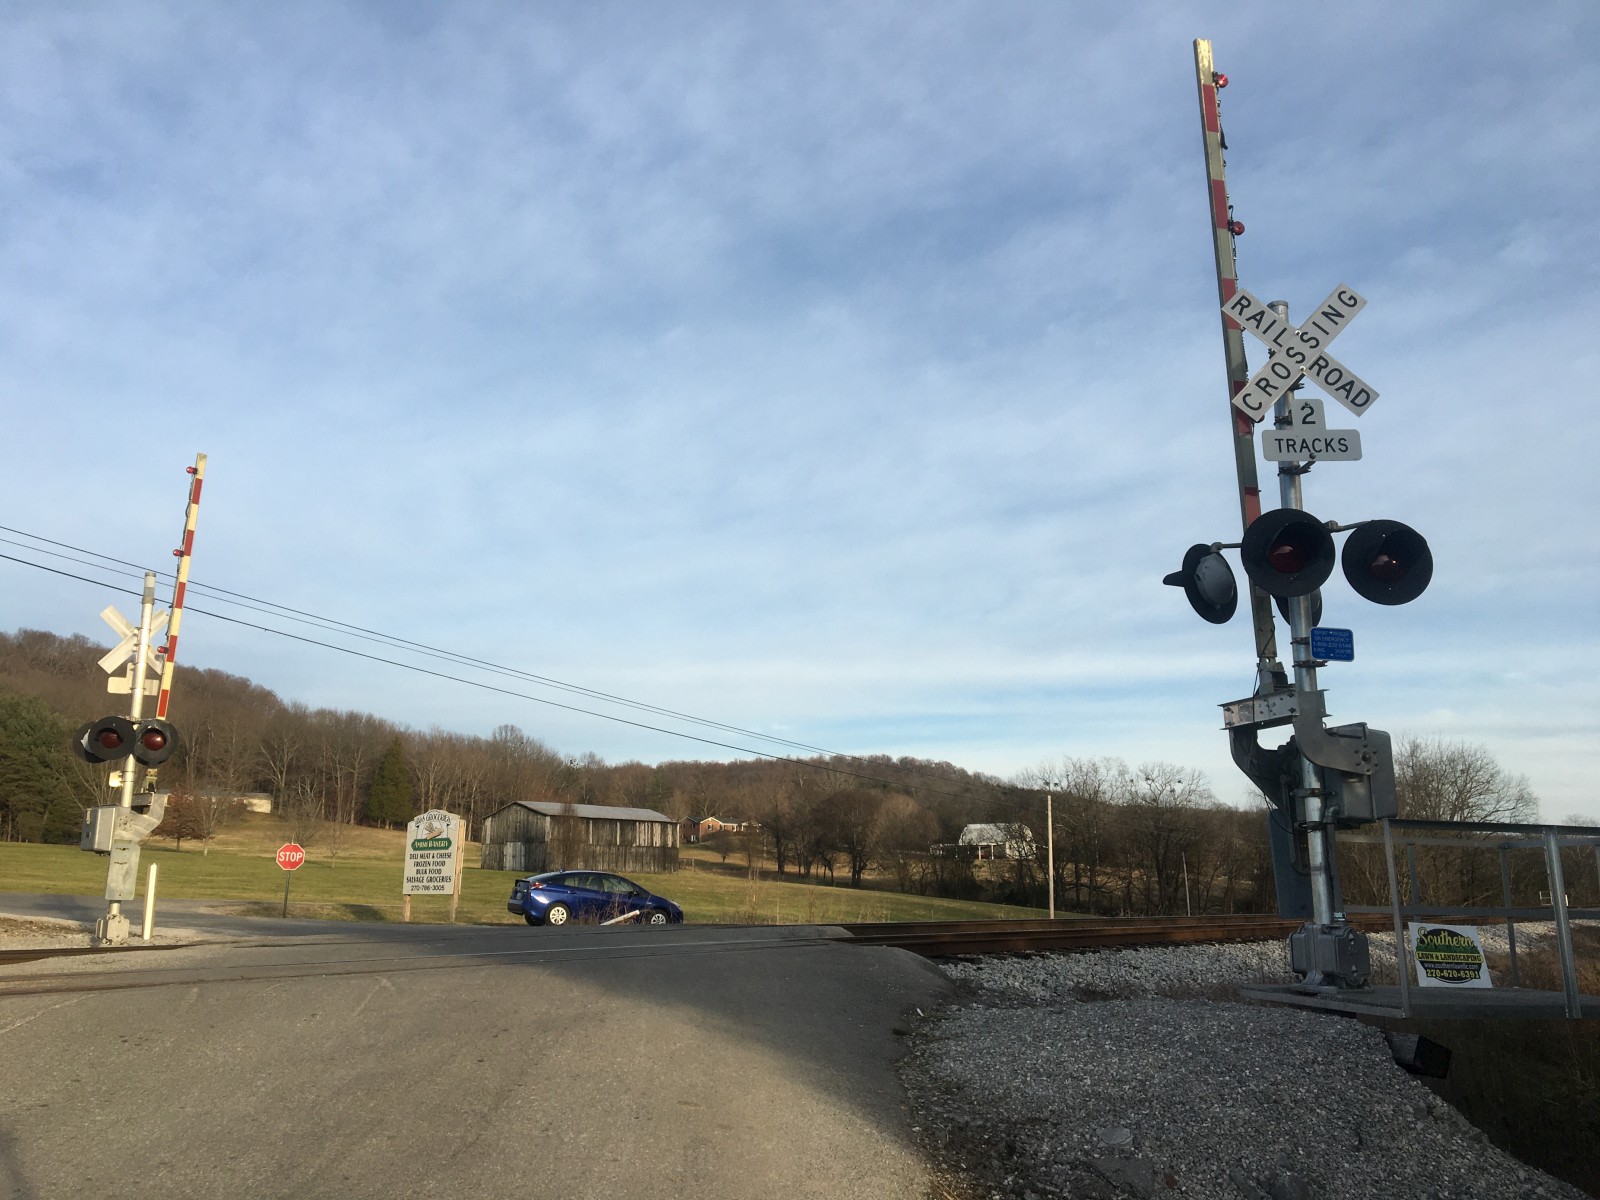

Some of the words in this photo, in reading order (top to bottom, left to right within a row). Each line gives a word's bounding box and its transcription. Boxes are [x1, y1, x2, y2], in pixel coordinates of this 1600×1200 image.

[1230, 295, 1288, 348] RAIL
[1308, 355, 1371, 408] ROAD
[1242, 290, 1358, 412] CROSSING
[1300, 404, 1316, 425] 2
[1275, 437, 1349, 454] TRACKS
[278, 852, 303, 862] STOP
[1417, 926, 1474, 946] Southern
[1440, 953, 1482, 962] LANDSCAPING
[1426, 969, 1479, 978] 270-670-6391
